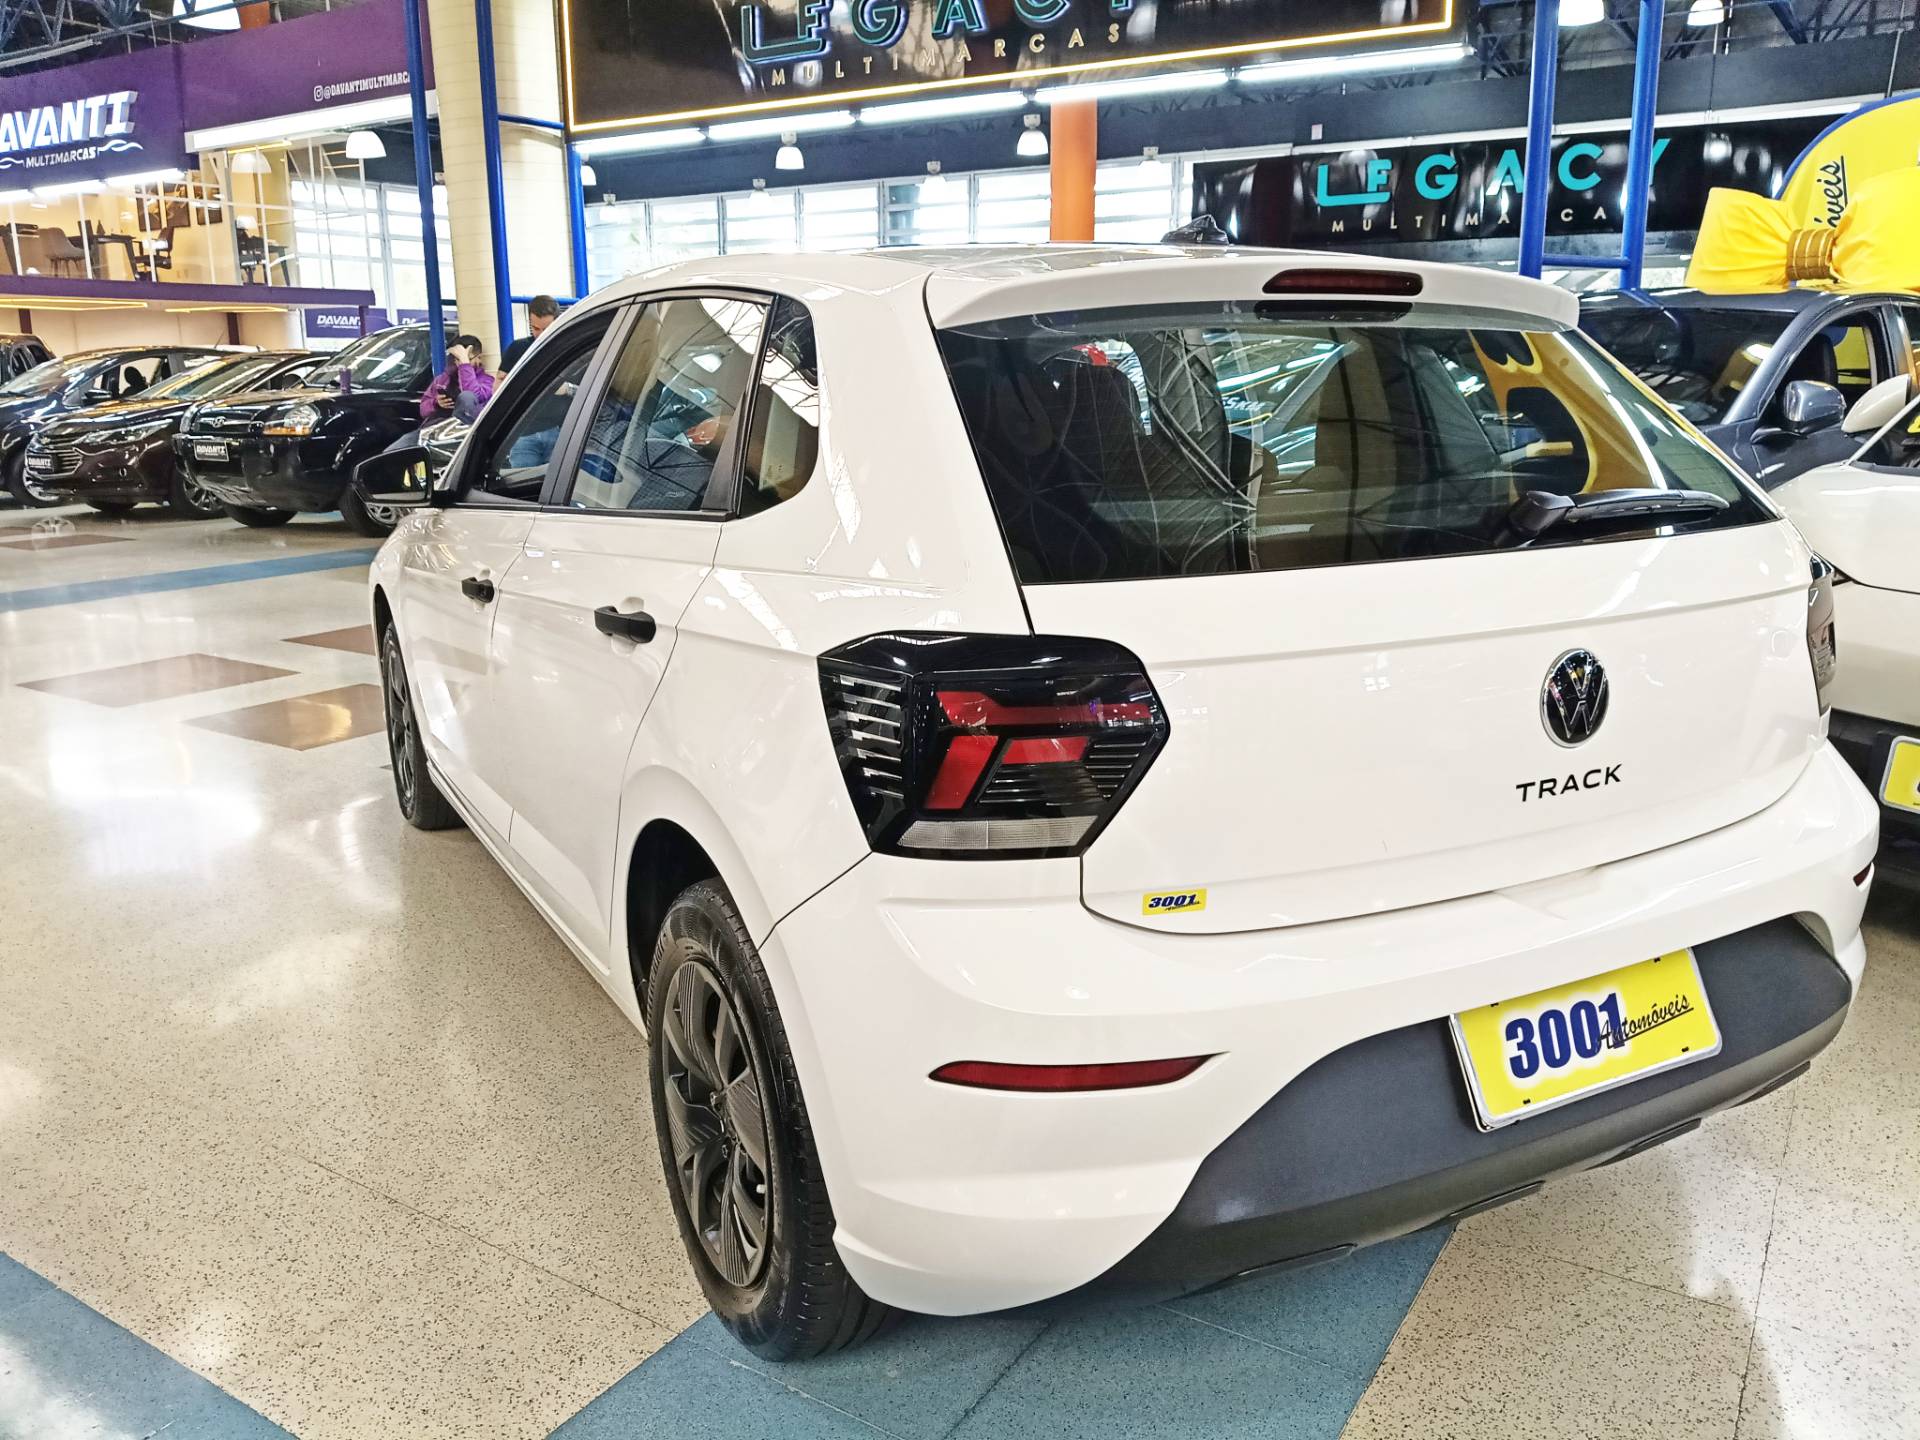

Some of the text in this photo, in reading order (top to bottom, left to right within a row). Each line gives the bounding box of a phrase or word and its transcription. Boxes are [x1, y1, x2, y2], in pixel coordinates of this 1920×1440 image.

[741, 0, 1131, 64] LEGA
[771, 23, 1120, 87] MULTIMARCAS
[323, 71, 410, 99] @DAVANTIMULTIMARC
[26, 146, 97, 168] MULTIMARCAS
[1515, 763, 1622, 802] TRACK
[1148, 894, 1197, 908] 3001
[1504, 992, 1693, 1079] 3001 Automóveis
